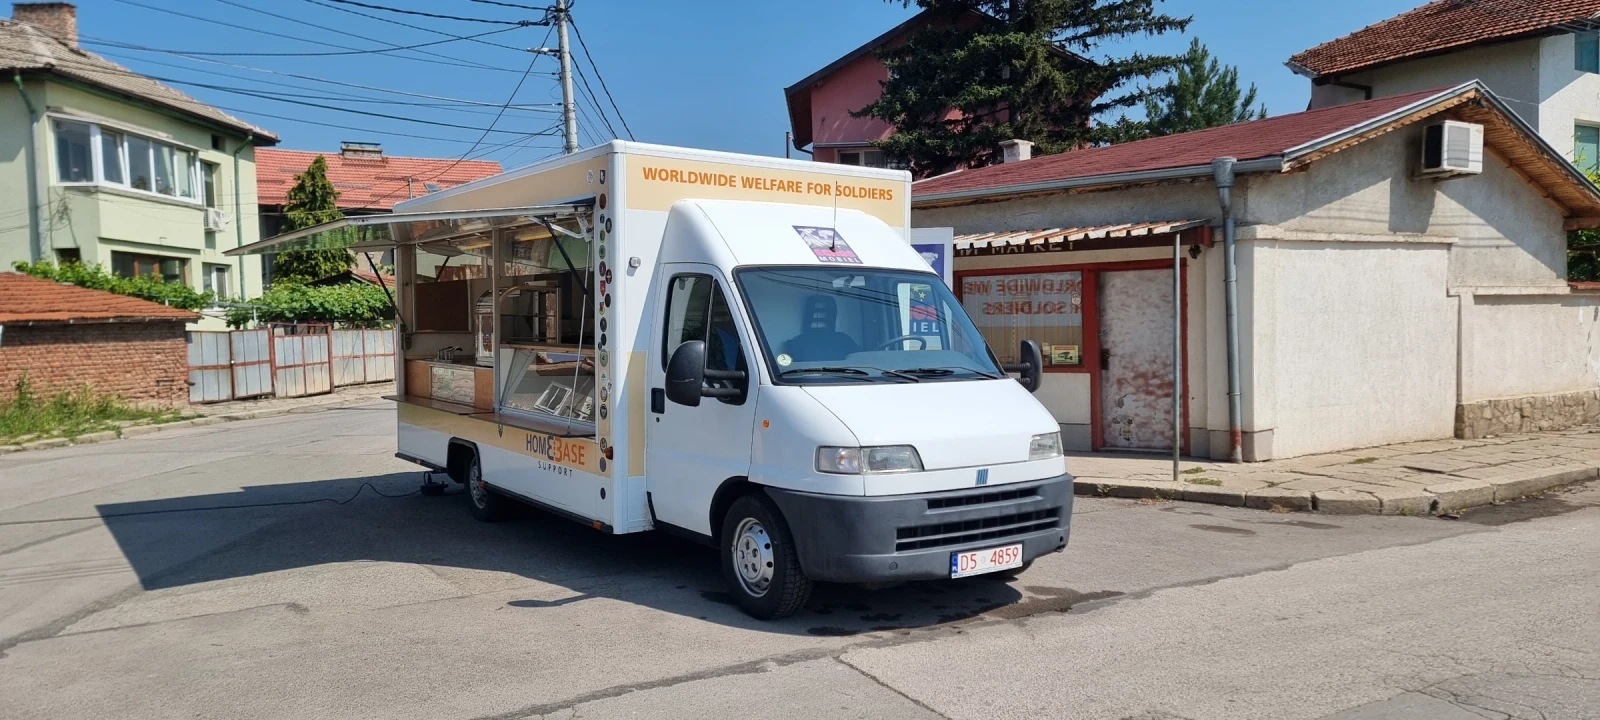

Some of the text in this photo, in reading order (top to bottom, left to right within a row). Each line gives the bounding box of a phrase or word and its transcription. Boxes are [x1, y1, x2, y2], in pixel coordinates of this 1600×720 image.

[643, 167, 893, 201] WORLDWIDE WELFARE FOR SOLDIERS
[538, 461, 573, 477] SUPPORT
[961, 547, 1019, 571] D5 4859
